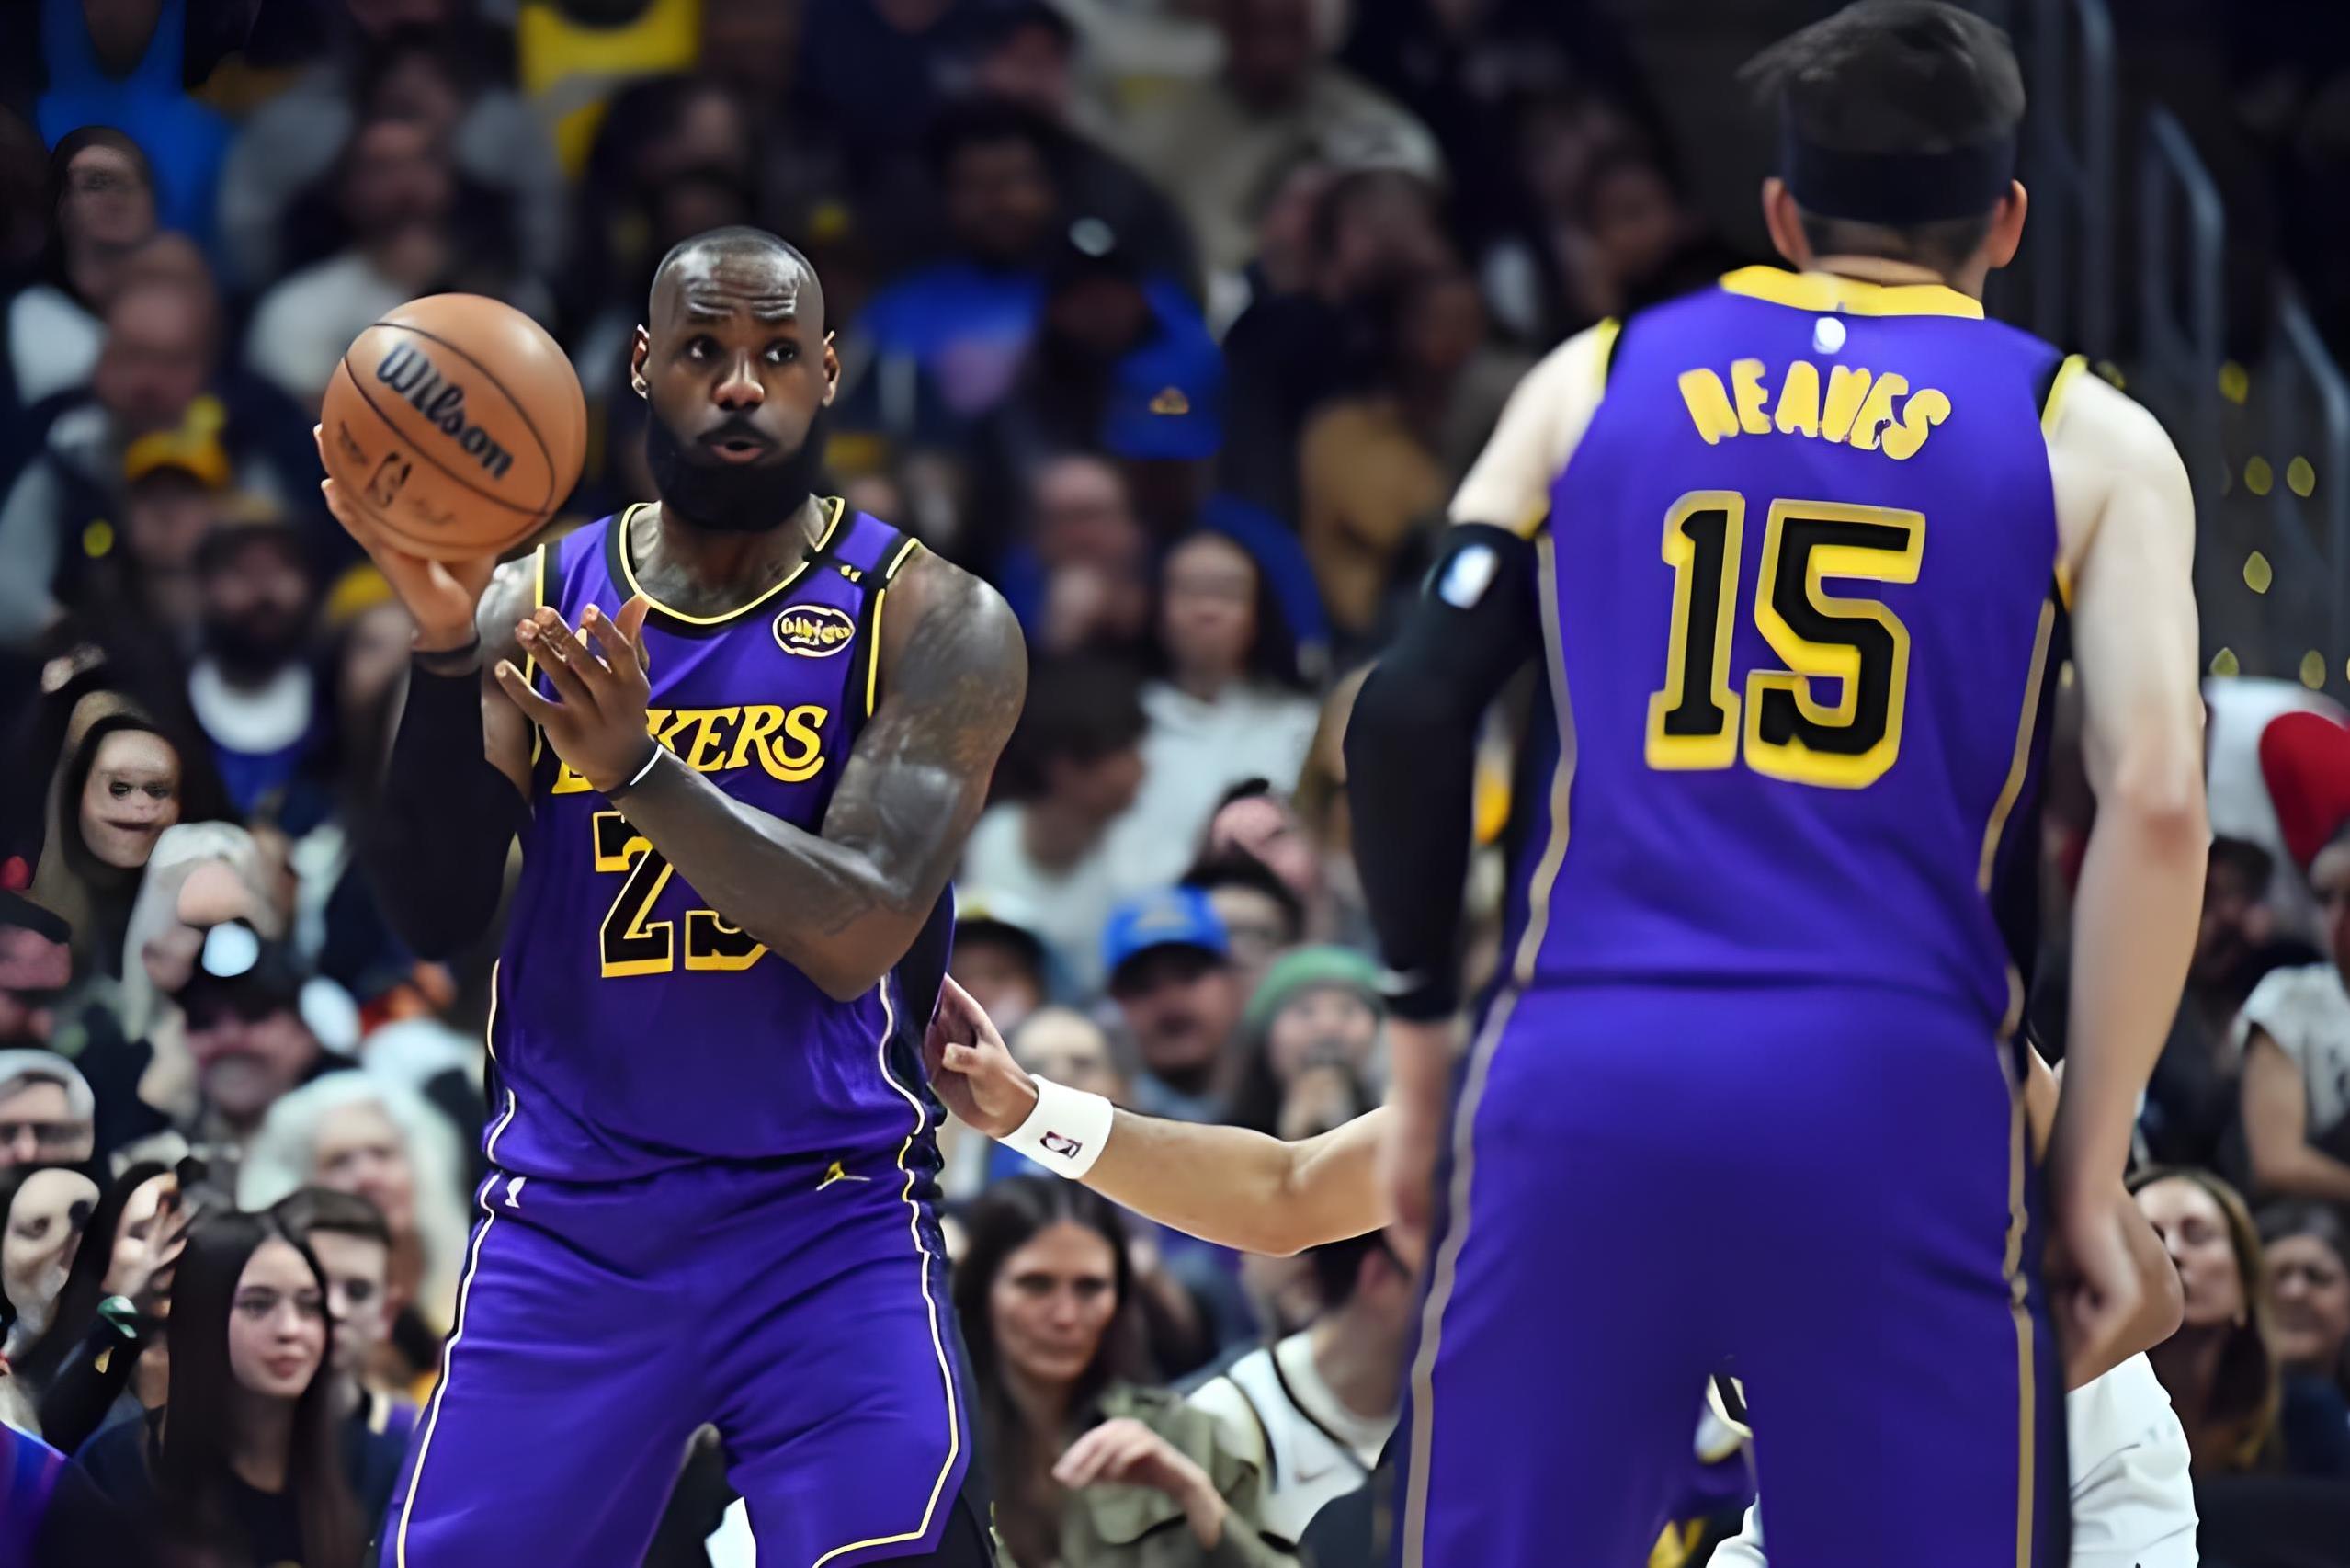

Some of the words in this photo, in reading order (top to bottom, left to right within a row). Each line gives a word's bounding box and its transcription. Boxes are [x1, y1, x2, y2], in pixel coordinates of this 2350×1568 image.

[376, 340, 515, 482] Wilson
[1677, 358, 1952, 460] REAVES
[1644, 489, 1926, 790] 15
[551, 704, 829, 795] KERS
